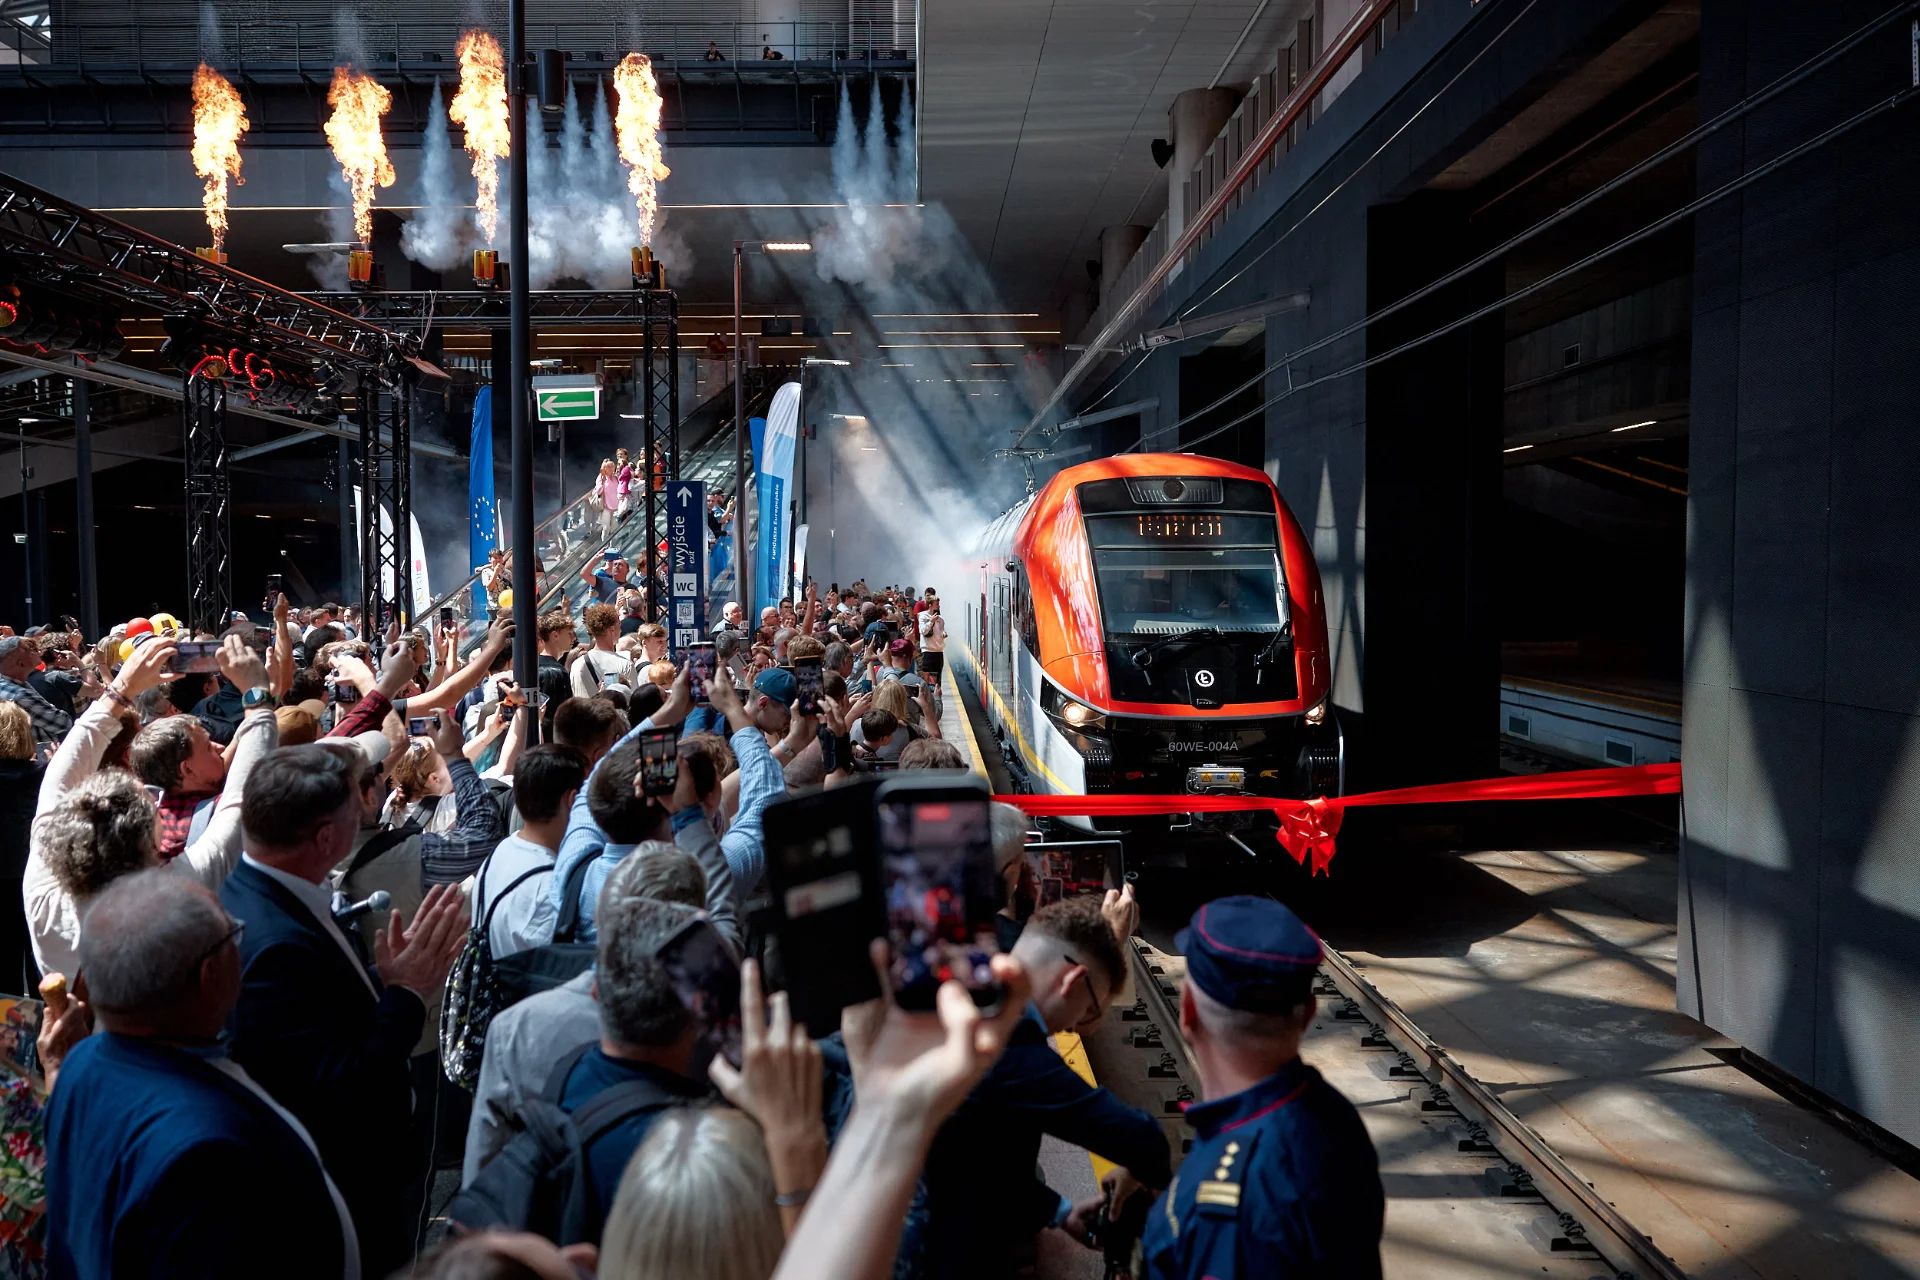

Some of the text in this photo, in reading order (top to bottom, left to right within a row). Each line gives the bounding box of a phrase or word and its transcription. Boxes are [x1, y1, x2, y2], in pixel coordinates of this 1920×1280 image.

[672, 515, 689, 567] wyjście
[675, 582, 695, 592] WC
[1168, 741, 1239, 752] 60WE-004A
